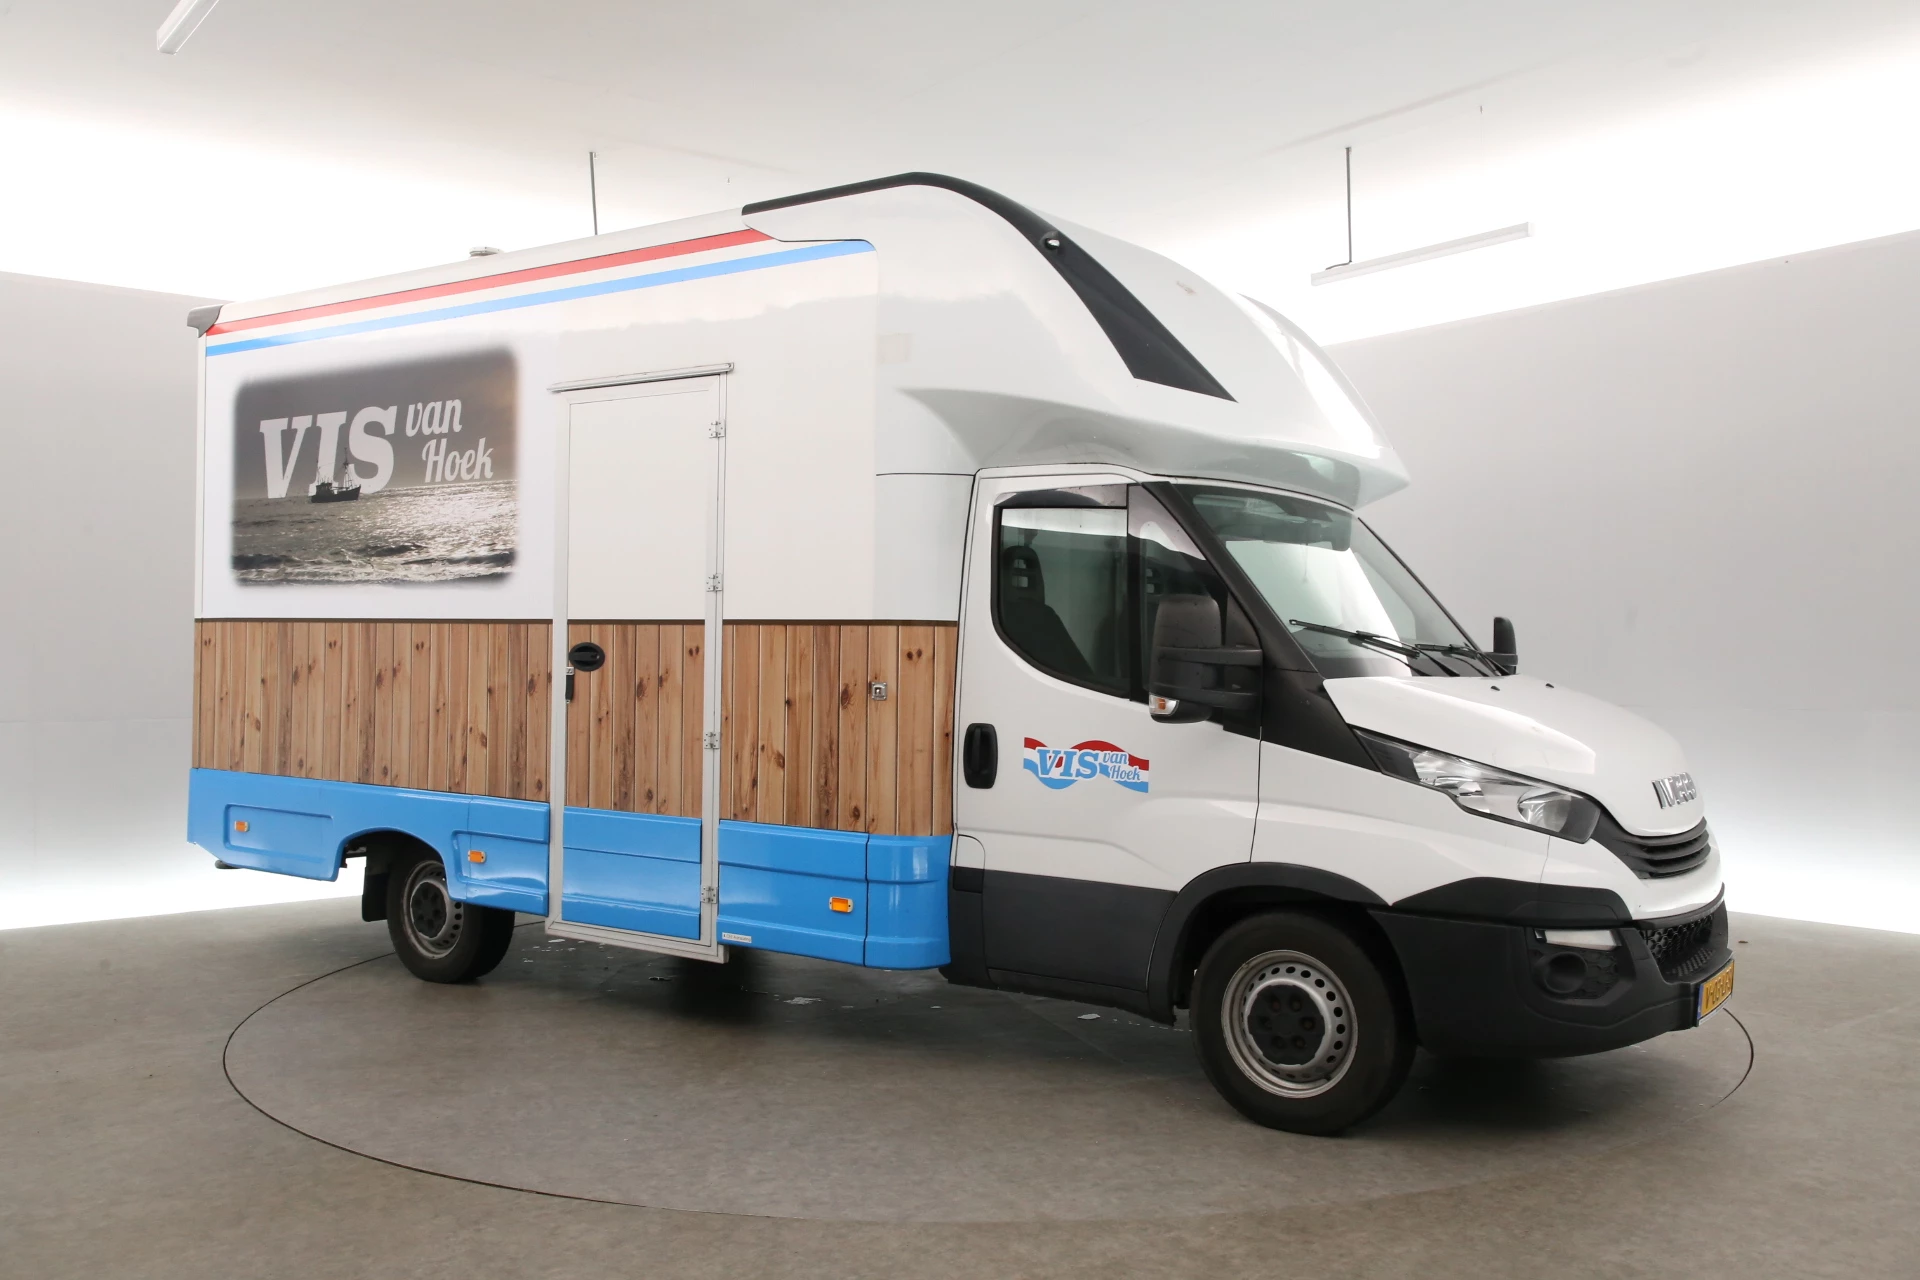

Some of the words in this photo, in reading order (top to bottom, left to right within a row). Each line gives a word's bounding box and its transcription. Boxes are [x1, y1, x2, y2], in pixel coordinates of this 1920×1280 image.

[259, 405, 398, 499] VIS
[405, 399, 463, 437] van
[421, 437, 494, 483] Hoek
[1037, 748, 1100, 779] VIS
[1102, 752, 1128, 765] van
[1109, 765, 1141, 781] Hoek
